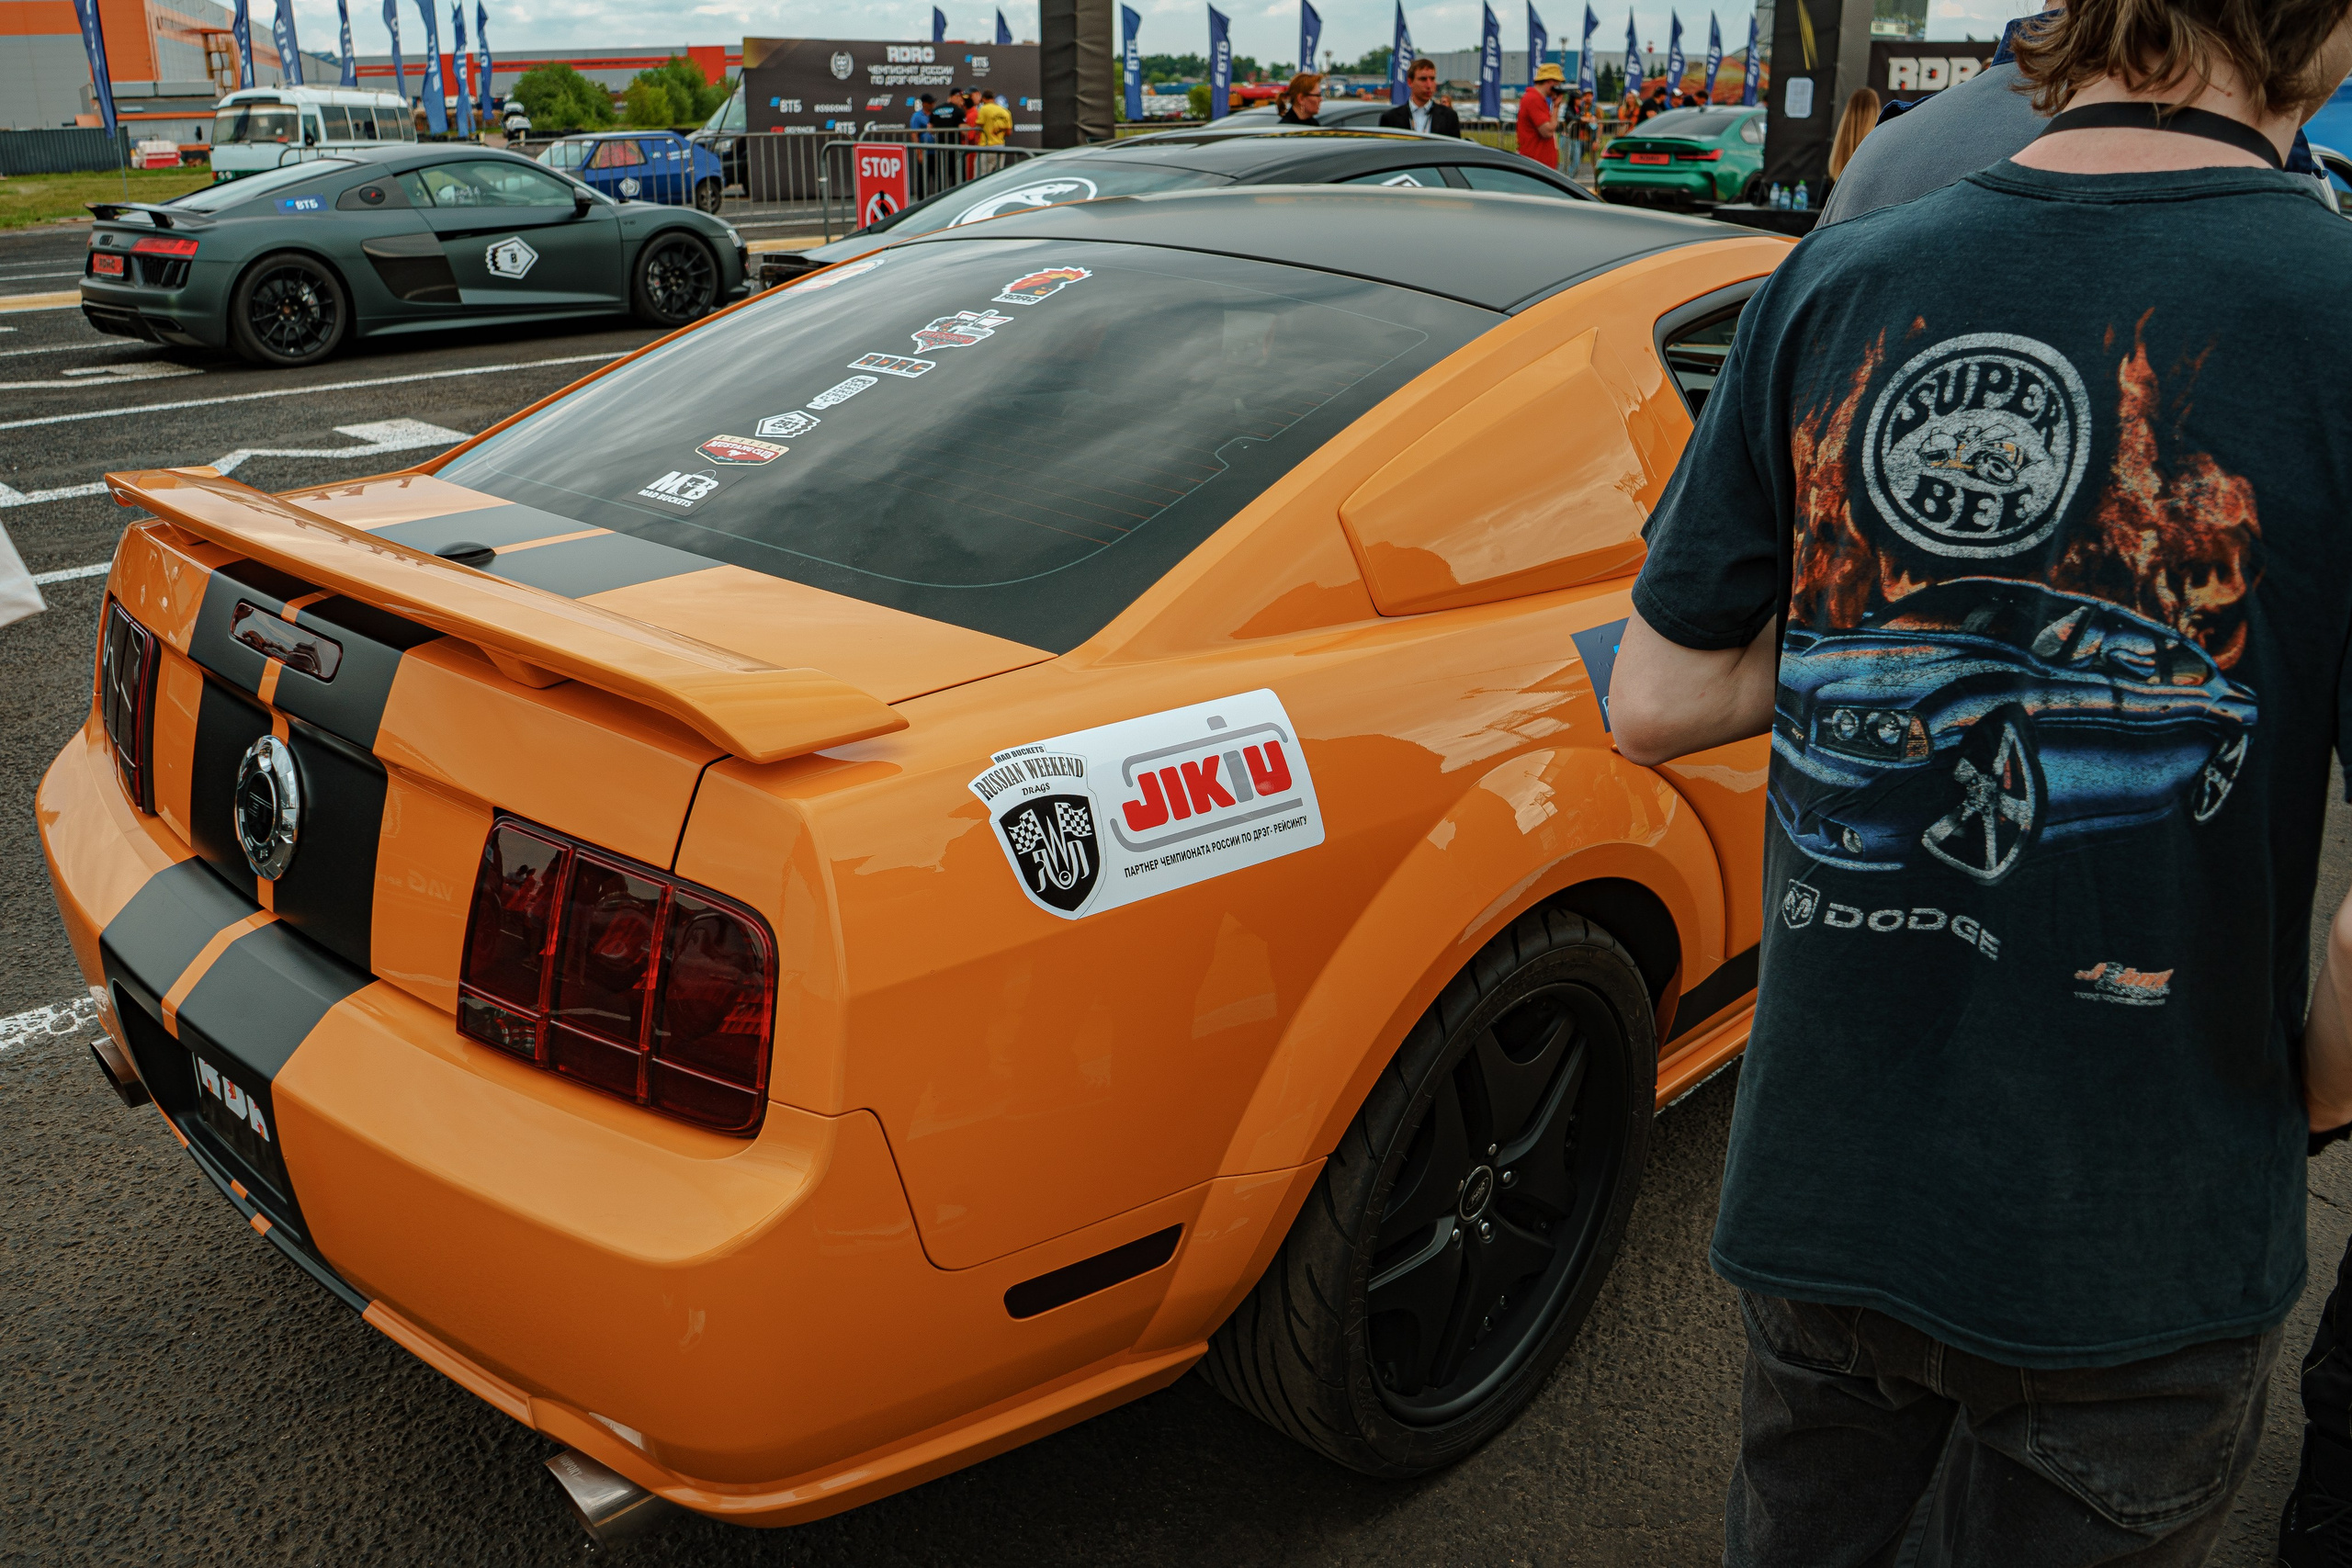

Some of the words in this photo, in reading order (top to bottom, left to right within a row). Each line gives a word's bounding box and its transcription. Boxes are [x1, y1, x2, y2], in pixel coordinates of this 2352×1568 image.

[887, 46, 935, 63] RDRC
[1888, 56, 1994, 90] RDR
[780, 99, 802, 113] ВТБ
[861, 156, 901, 178] STOP
[295, 197, 319, 211] ВТБ
[1893, 362, 2063, 455] SUPER
[706, 440, 754, 453] MUSTANG
[752, 447, 775, 459] CLUB
[719, 435, 784, 451] RUSSIAN
[638, 489, 658, 500] MAD
[657, 491, 695, 507] BUCKETS
[1905, 473, 2033, 534] BEE
[994, 751, 1012, 764] MAD
[1011, 745, 1046, 760] BUCKETS
[974, 760, 1027, 801] RUSSIAN
[1026, 756, 1085, 782] WEEKEND
[1021, 783, 1051, 796] DRAGS
[1124, 858, 1159, 879] ПАРТНЕР
[1160, 844, 1212, 868] ЧЕМПИОНАТА
[1211, 836, 1240, 854] РОССИИ
[1241, 832, 1253, 845] ПО
[1274, 815, 1308, 837] РЕЙСИНГУ
[1823, 902, 2001, 961] DODGE
